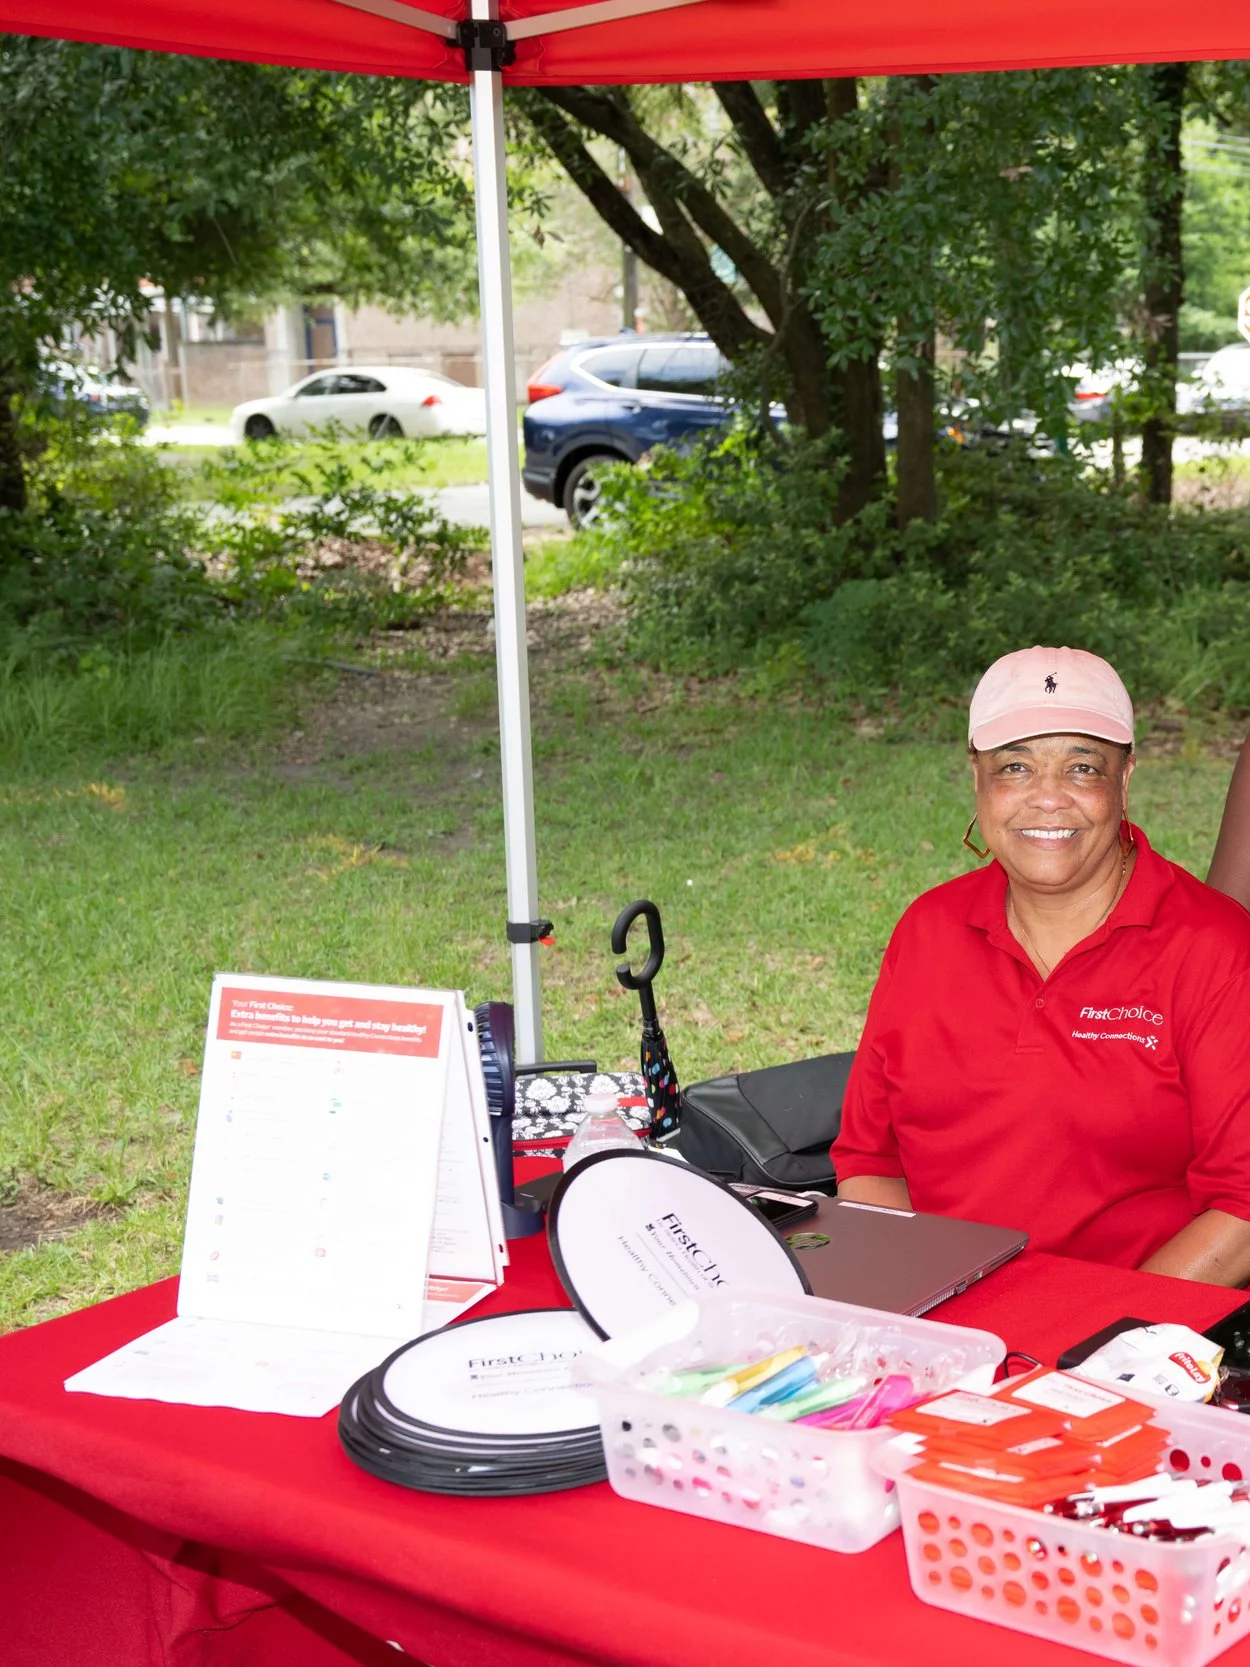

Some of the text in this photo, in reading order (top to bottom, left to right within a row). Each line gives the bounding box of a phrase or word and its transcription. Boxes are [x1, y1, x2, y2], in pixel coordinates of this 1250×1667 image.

[249, 1000, 266, 1009] First
[231, 1009, 254, 1019] Extra
[1080, 1006, 1164, 1025] FirstChoice
[1072, 1031, 1145, 1044] Healthy Connections
